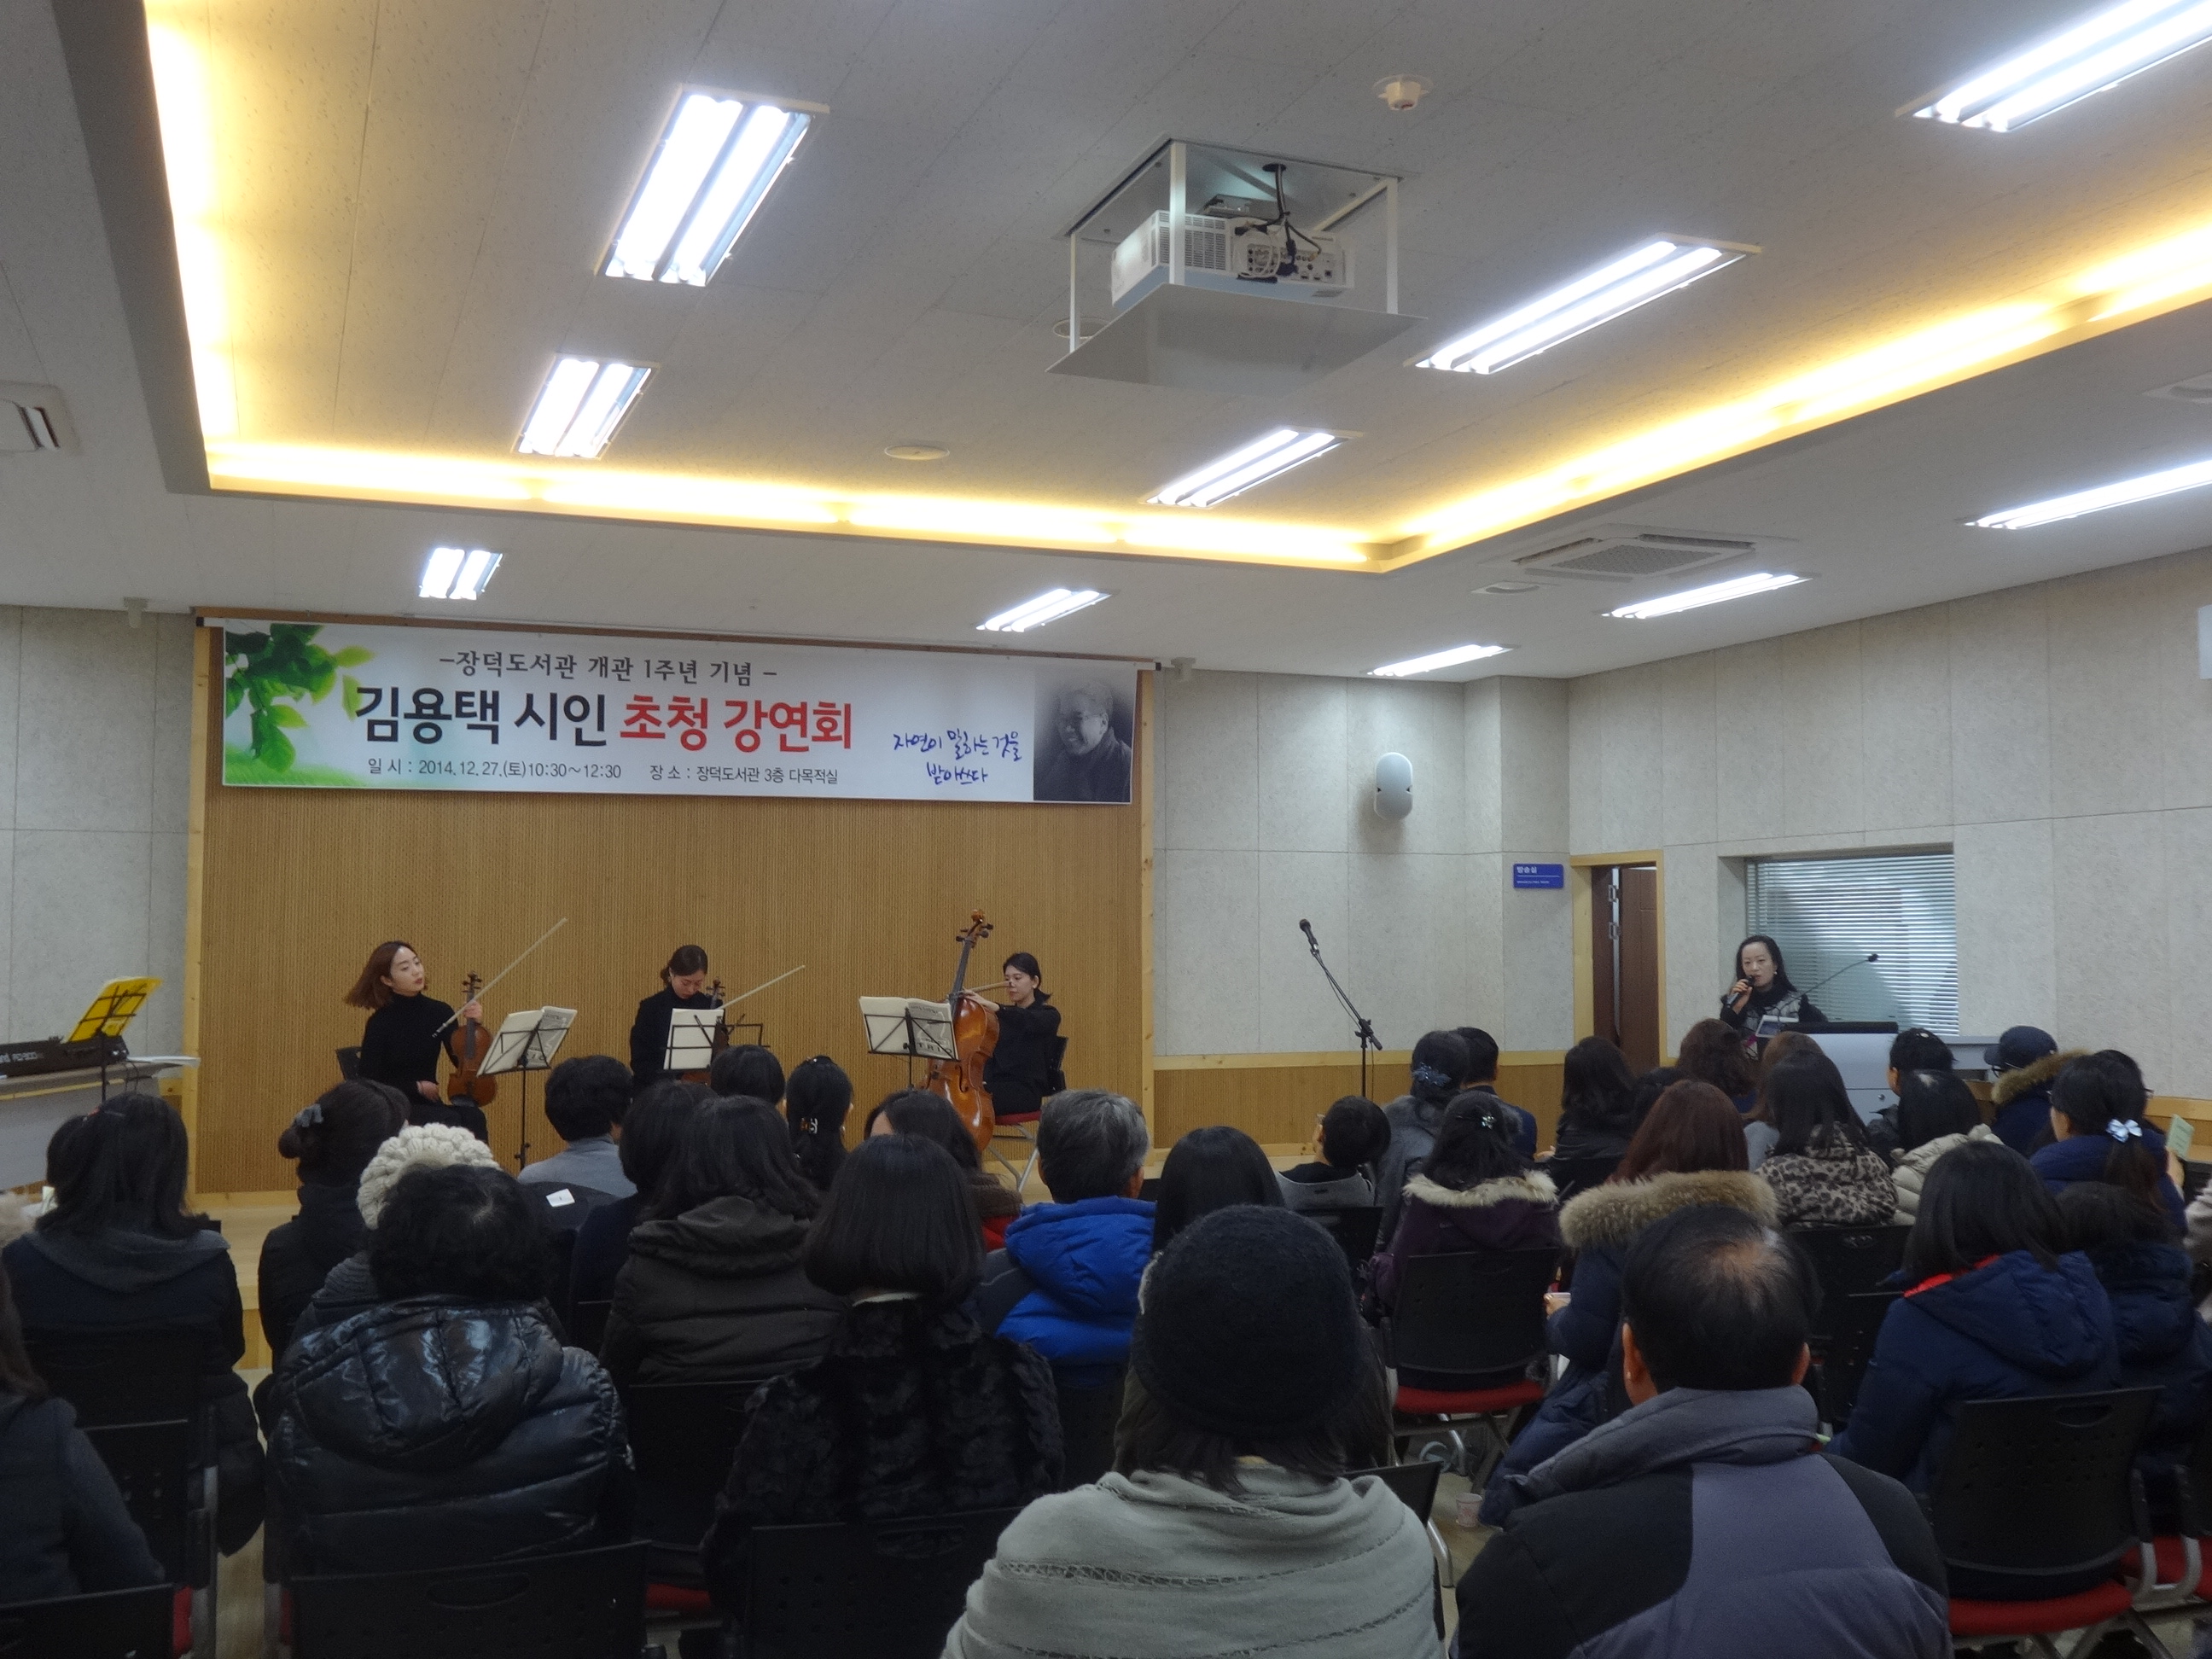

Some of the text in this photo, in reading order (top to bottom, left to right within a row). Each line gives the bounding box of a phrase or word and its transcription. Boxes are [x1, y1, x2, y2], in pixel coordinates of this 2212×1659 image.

[588, 656, 634, 682] 개관
[644, 659, 697, 684] 1주년
[710, 661, 752, 687] 기념
[355, 686, 852, 753] 김용택 시인 초청 강연회
[894, 732, 942, 753] 자연이
[992, 731, 1022, 762] 것을
[696, 765, 760, 783] 장덕도서관
[765, 768, 784, 783] 3층
[789, 769, 839, 784] 다목적실
